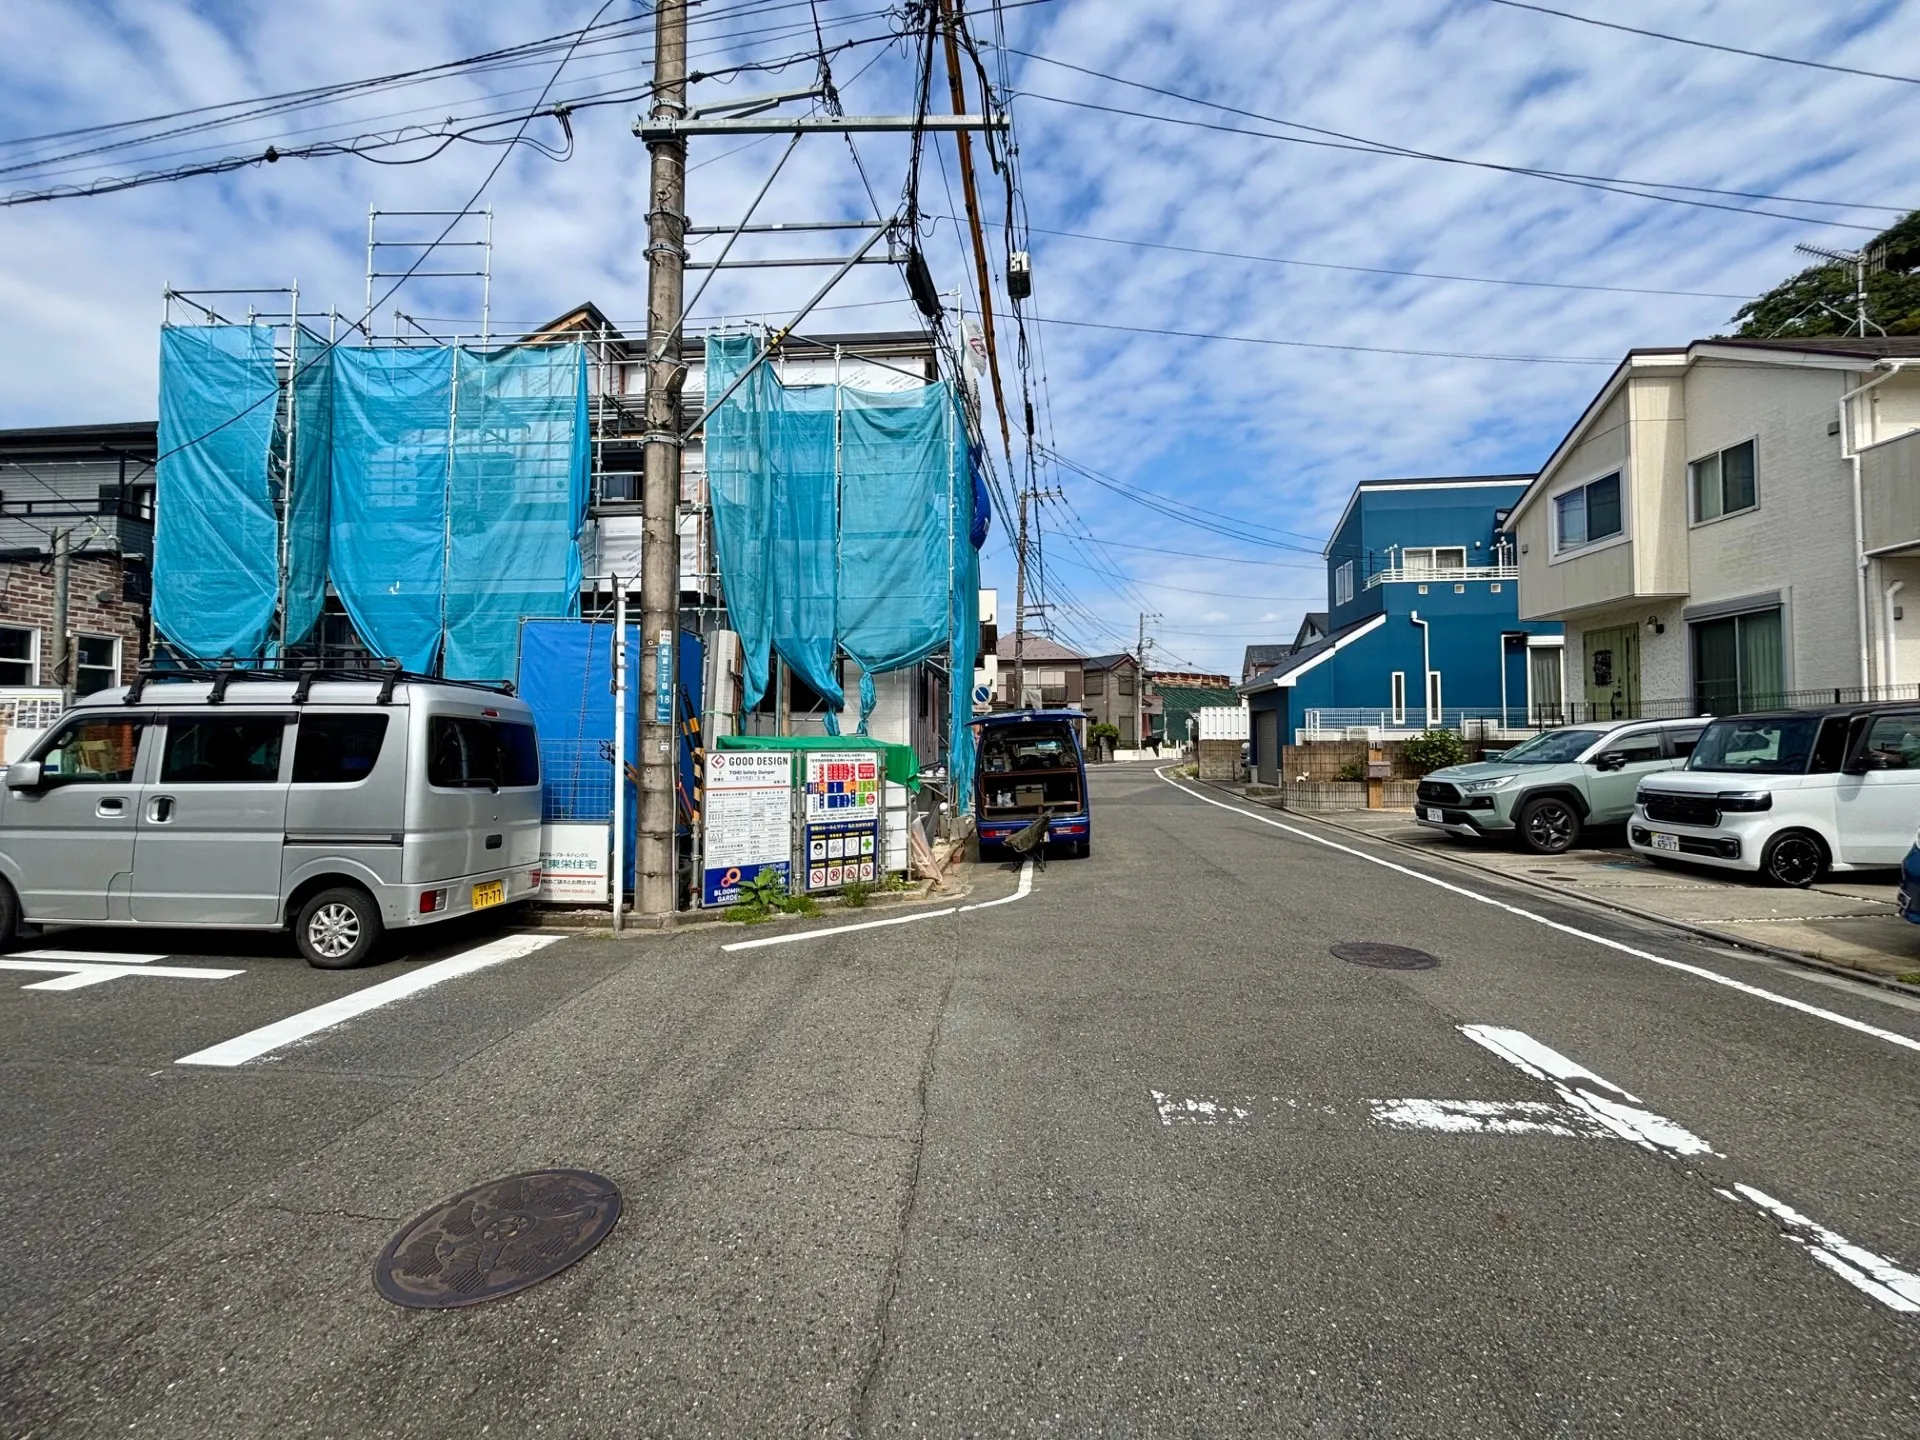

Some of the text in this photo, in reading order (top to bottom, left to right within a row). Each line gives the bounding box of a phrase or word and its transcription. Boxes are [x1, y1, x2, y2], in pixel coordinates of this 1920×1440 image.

[659, 694, 670, 704] 18
[729, 756, 788, 766] GOOD DESIGN
[479, 889, 501, 906] 77-77
